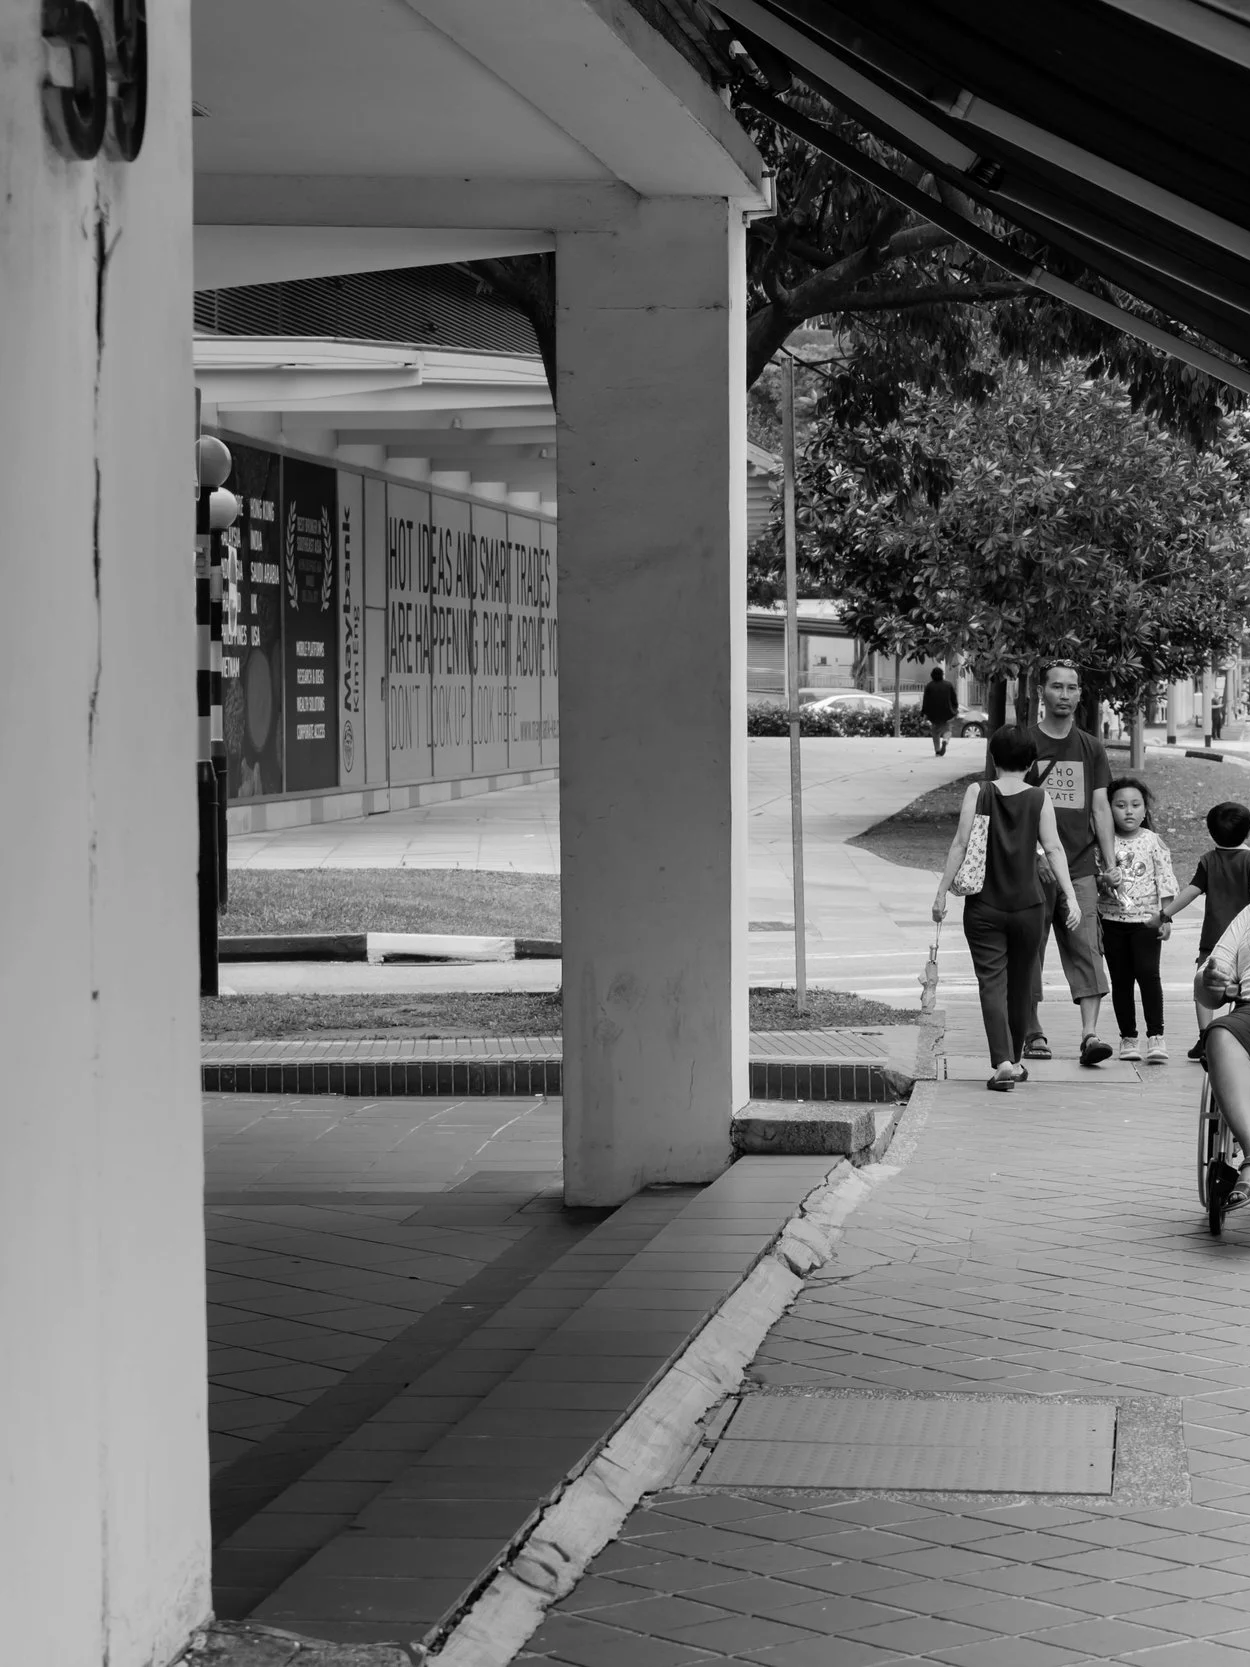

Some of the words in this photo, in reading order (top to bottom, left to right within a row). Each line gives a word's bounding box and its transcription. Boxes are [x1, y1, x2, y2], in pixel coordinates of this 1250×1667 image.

[250, 499, 262, 519] HONG
[262, 501, 275, 521] KONG
[250, 529, 263, 551] INDIA
[251, 562, 264, 583] SAUDI
[264, 563, 280, 585] ARABIA
[389, 517, 413, 591] HOT
[418, 522, 452, 597] IDEAS
[456, 531, 478, 600] AND
[480, 536, 513, 604] SMART
[515, 543, 550, 609] TRADES
[342, 505, 353, 712] Maybank
[251, 626, 261, 646] USA
[353, 605, 361, 655] Eng
[389, 601, 413, 674] ARE
[415, 603, 478, 676] HAPPENING
[483, 611, 513, 677] RIGHT
[516, 615, 545, 677] ABOVE
[391, 685, 420, 750] DON'T
[426, 685, 452, 748] LOOK
[473, 685, 495, 745] LOOK
[1047, 777, 1074, 788] COO
